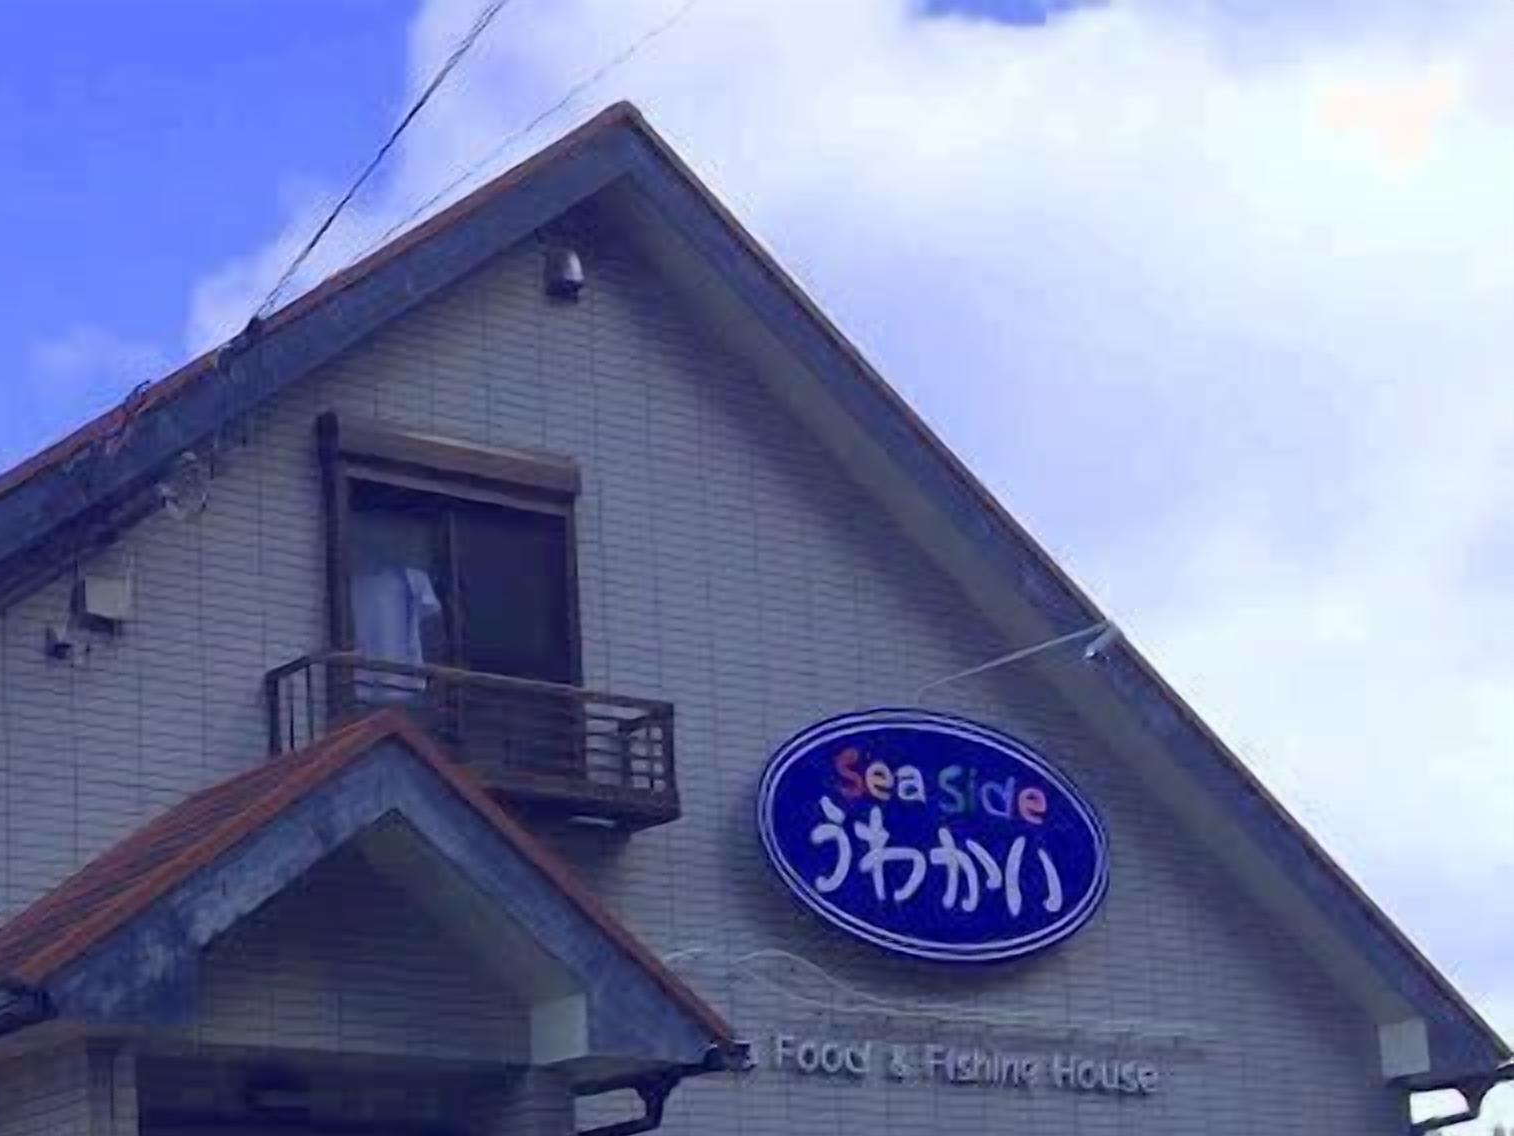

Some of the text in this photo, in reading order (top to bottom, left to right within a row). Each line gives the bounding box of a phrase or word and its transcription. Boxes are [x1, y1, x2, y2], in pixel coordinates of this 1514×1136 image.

[810, 796, 1063, 917] うわかい
[777, 1036, 870, 1074] Food
[1052, 1053, 1159, 1094] House
